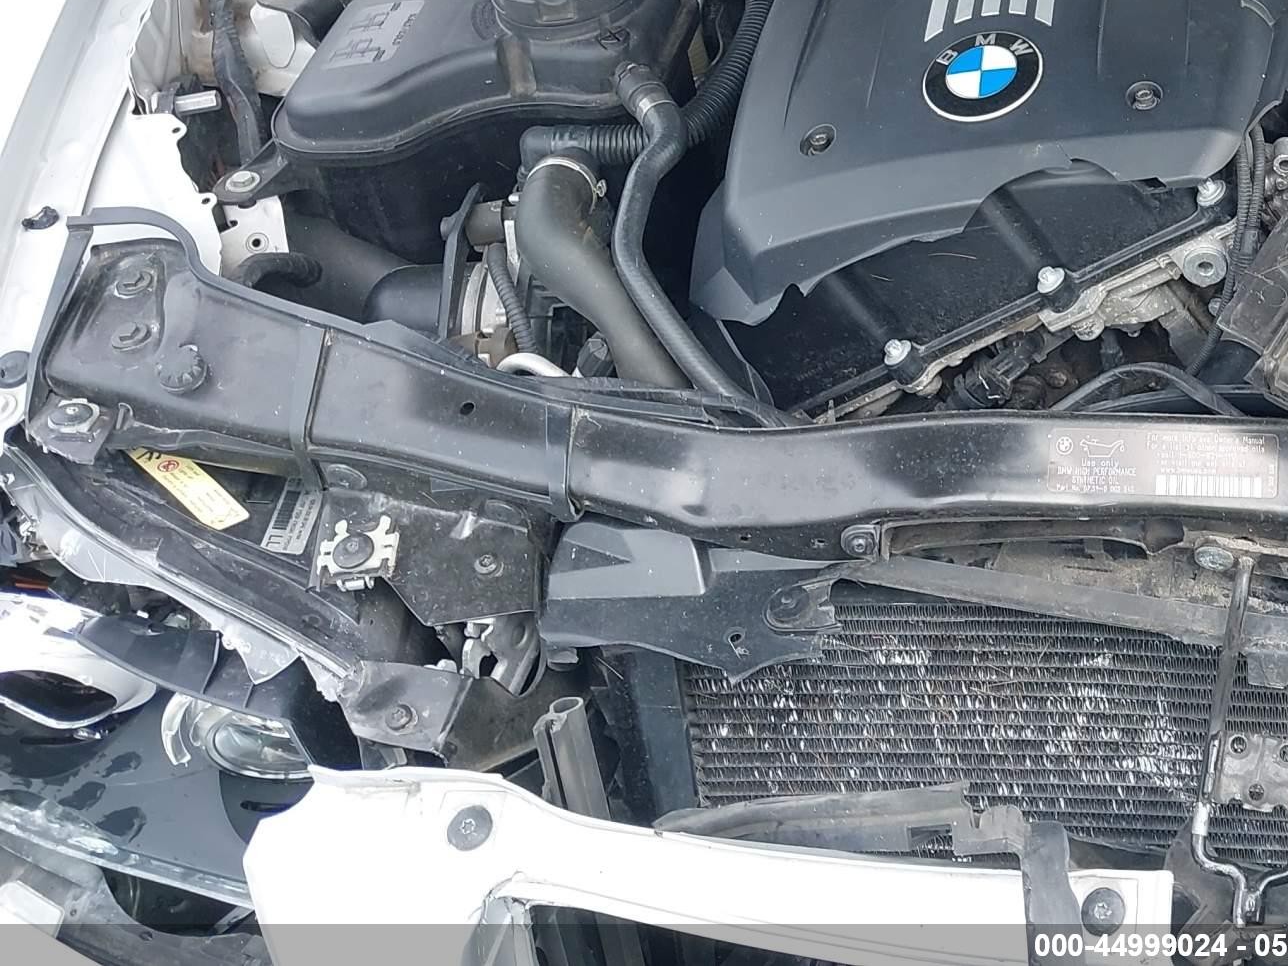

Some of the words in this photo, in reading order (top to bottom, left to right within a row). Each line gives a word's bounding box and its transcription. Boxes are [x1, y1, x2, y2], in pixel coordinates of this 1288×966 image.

[936, 34, 1034, 65] BMW
[1100, 458, 1120, 468] only
[1092, 466, 1137, 476] PERFORMANCE
[1071, 475, 1106, 485] SYNTHETIC
